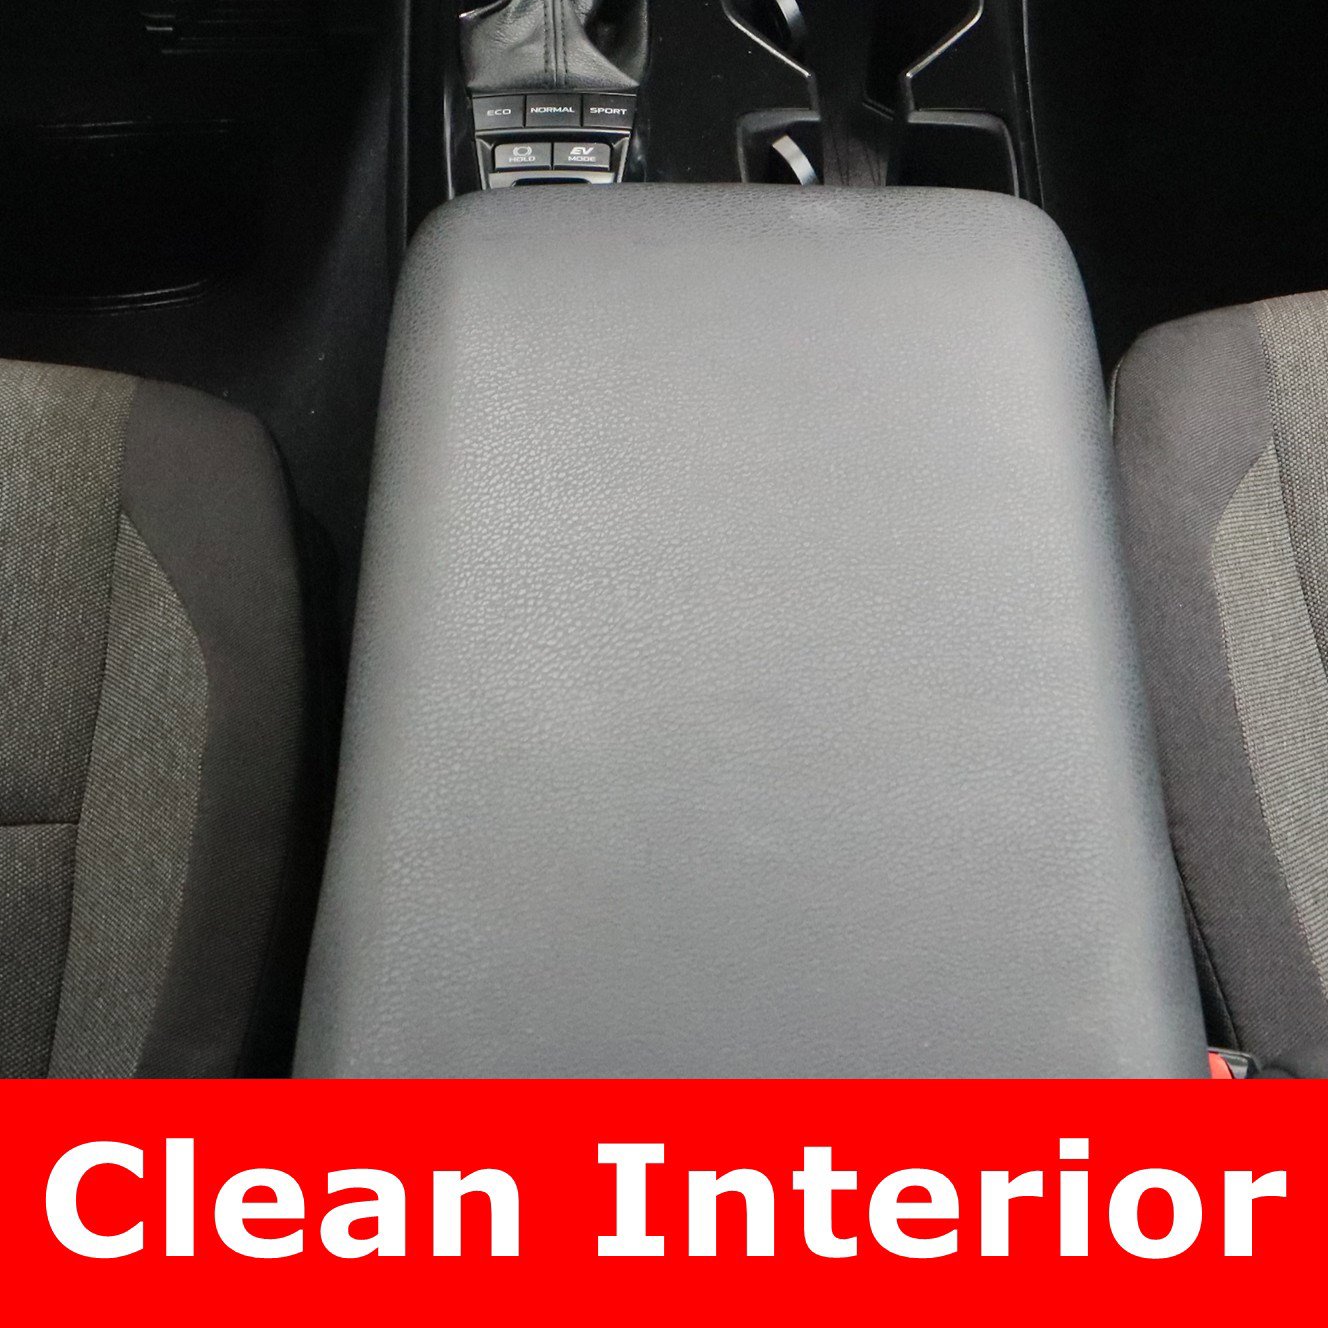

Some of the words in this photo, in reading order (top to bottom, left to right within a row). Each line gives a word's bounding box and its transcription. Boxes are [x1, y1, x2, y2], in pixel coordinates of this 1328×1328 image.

[487, 108, 512, 116] ECO
[590, 107, 627, 115] SPORT
[570, 147, 594, 155] EV
